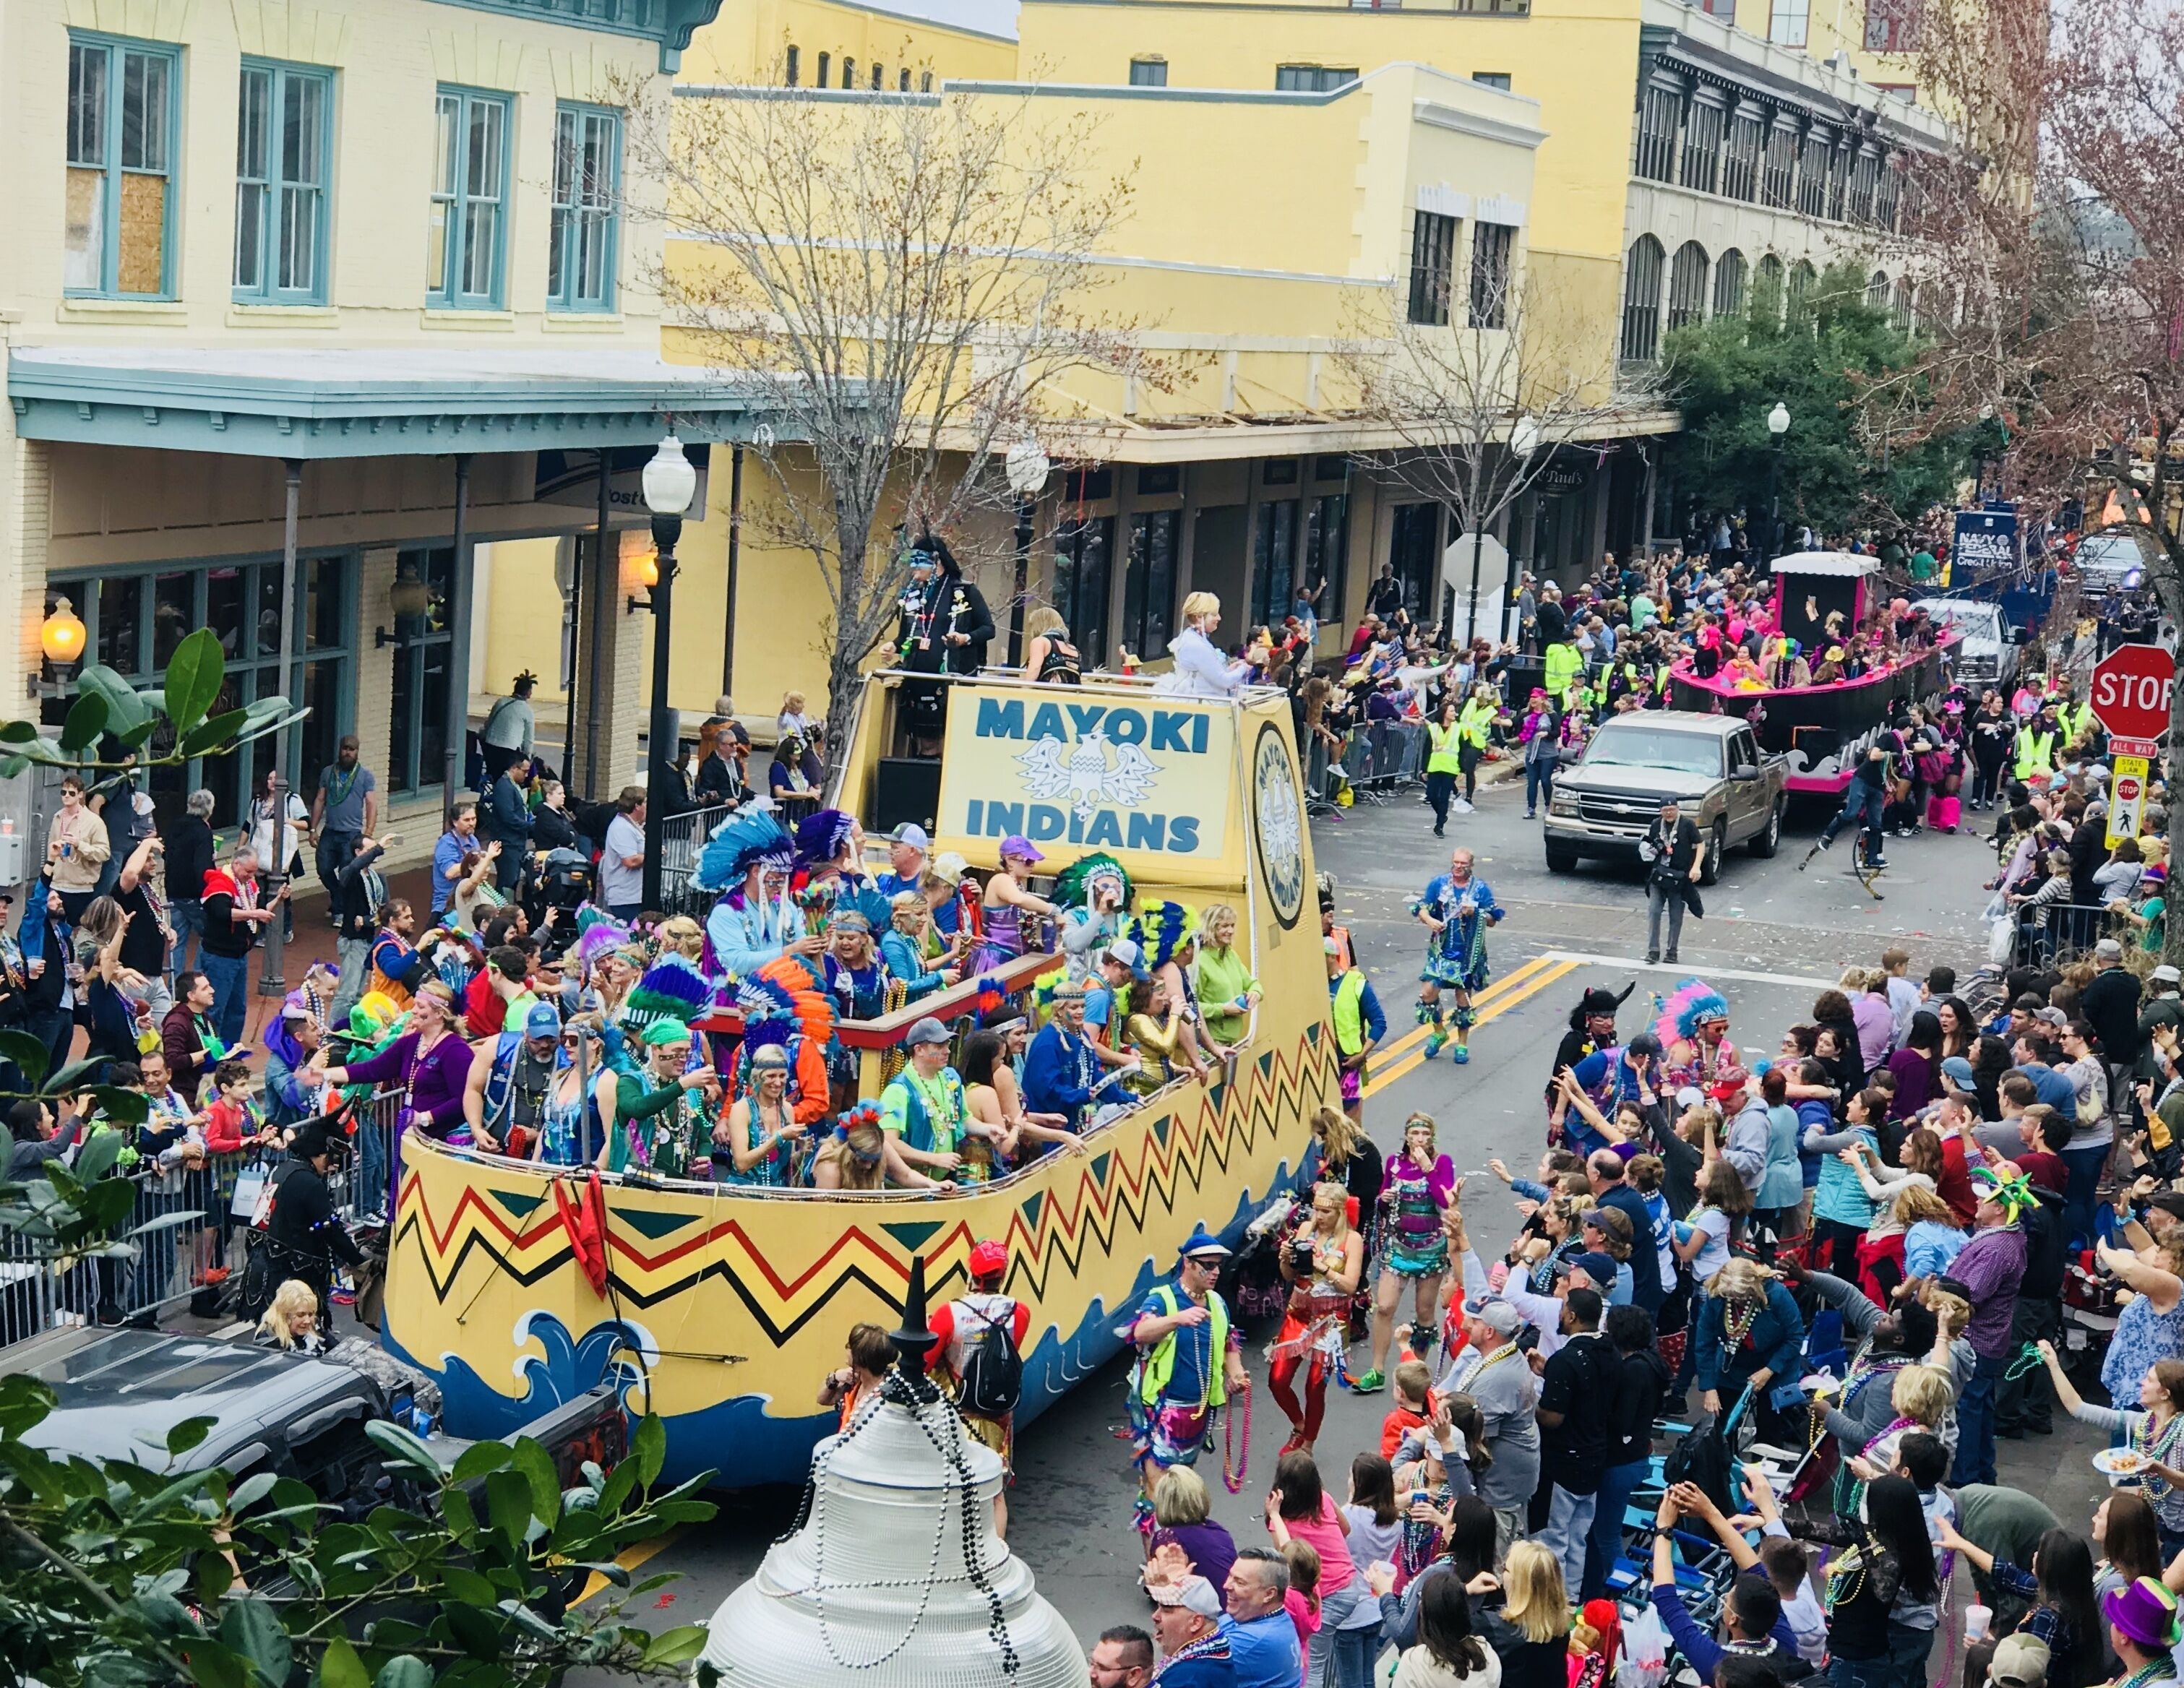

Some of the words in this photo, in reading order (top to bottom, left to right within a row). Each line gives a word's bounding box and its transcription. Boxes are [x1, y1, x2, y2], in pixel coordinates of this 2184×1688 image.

[1959, 532, 1996, 545] NAVY
[976, 697, 1210, 754] MAYOKI
[2112, 741, 2129, 752] ALL
[2135, 744, 2154, 755] WAY
[2119, 785, 2138, 794] STOP
[966, 799, 1200, 853] INDIANS
